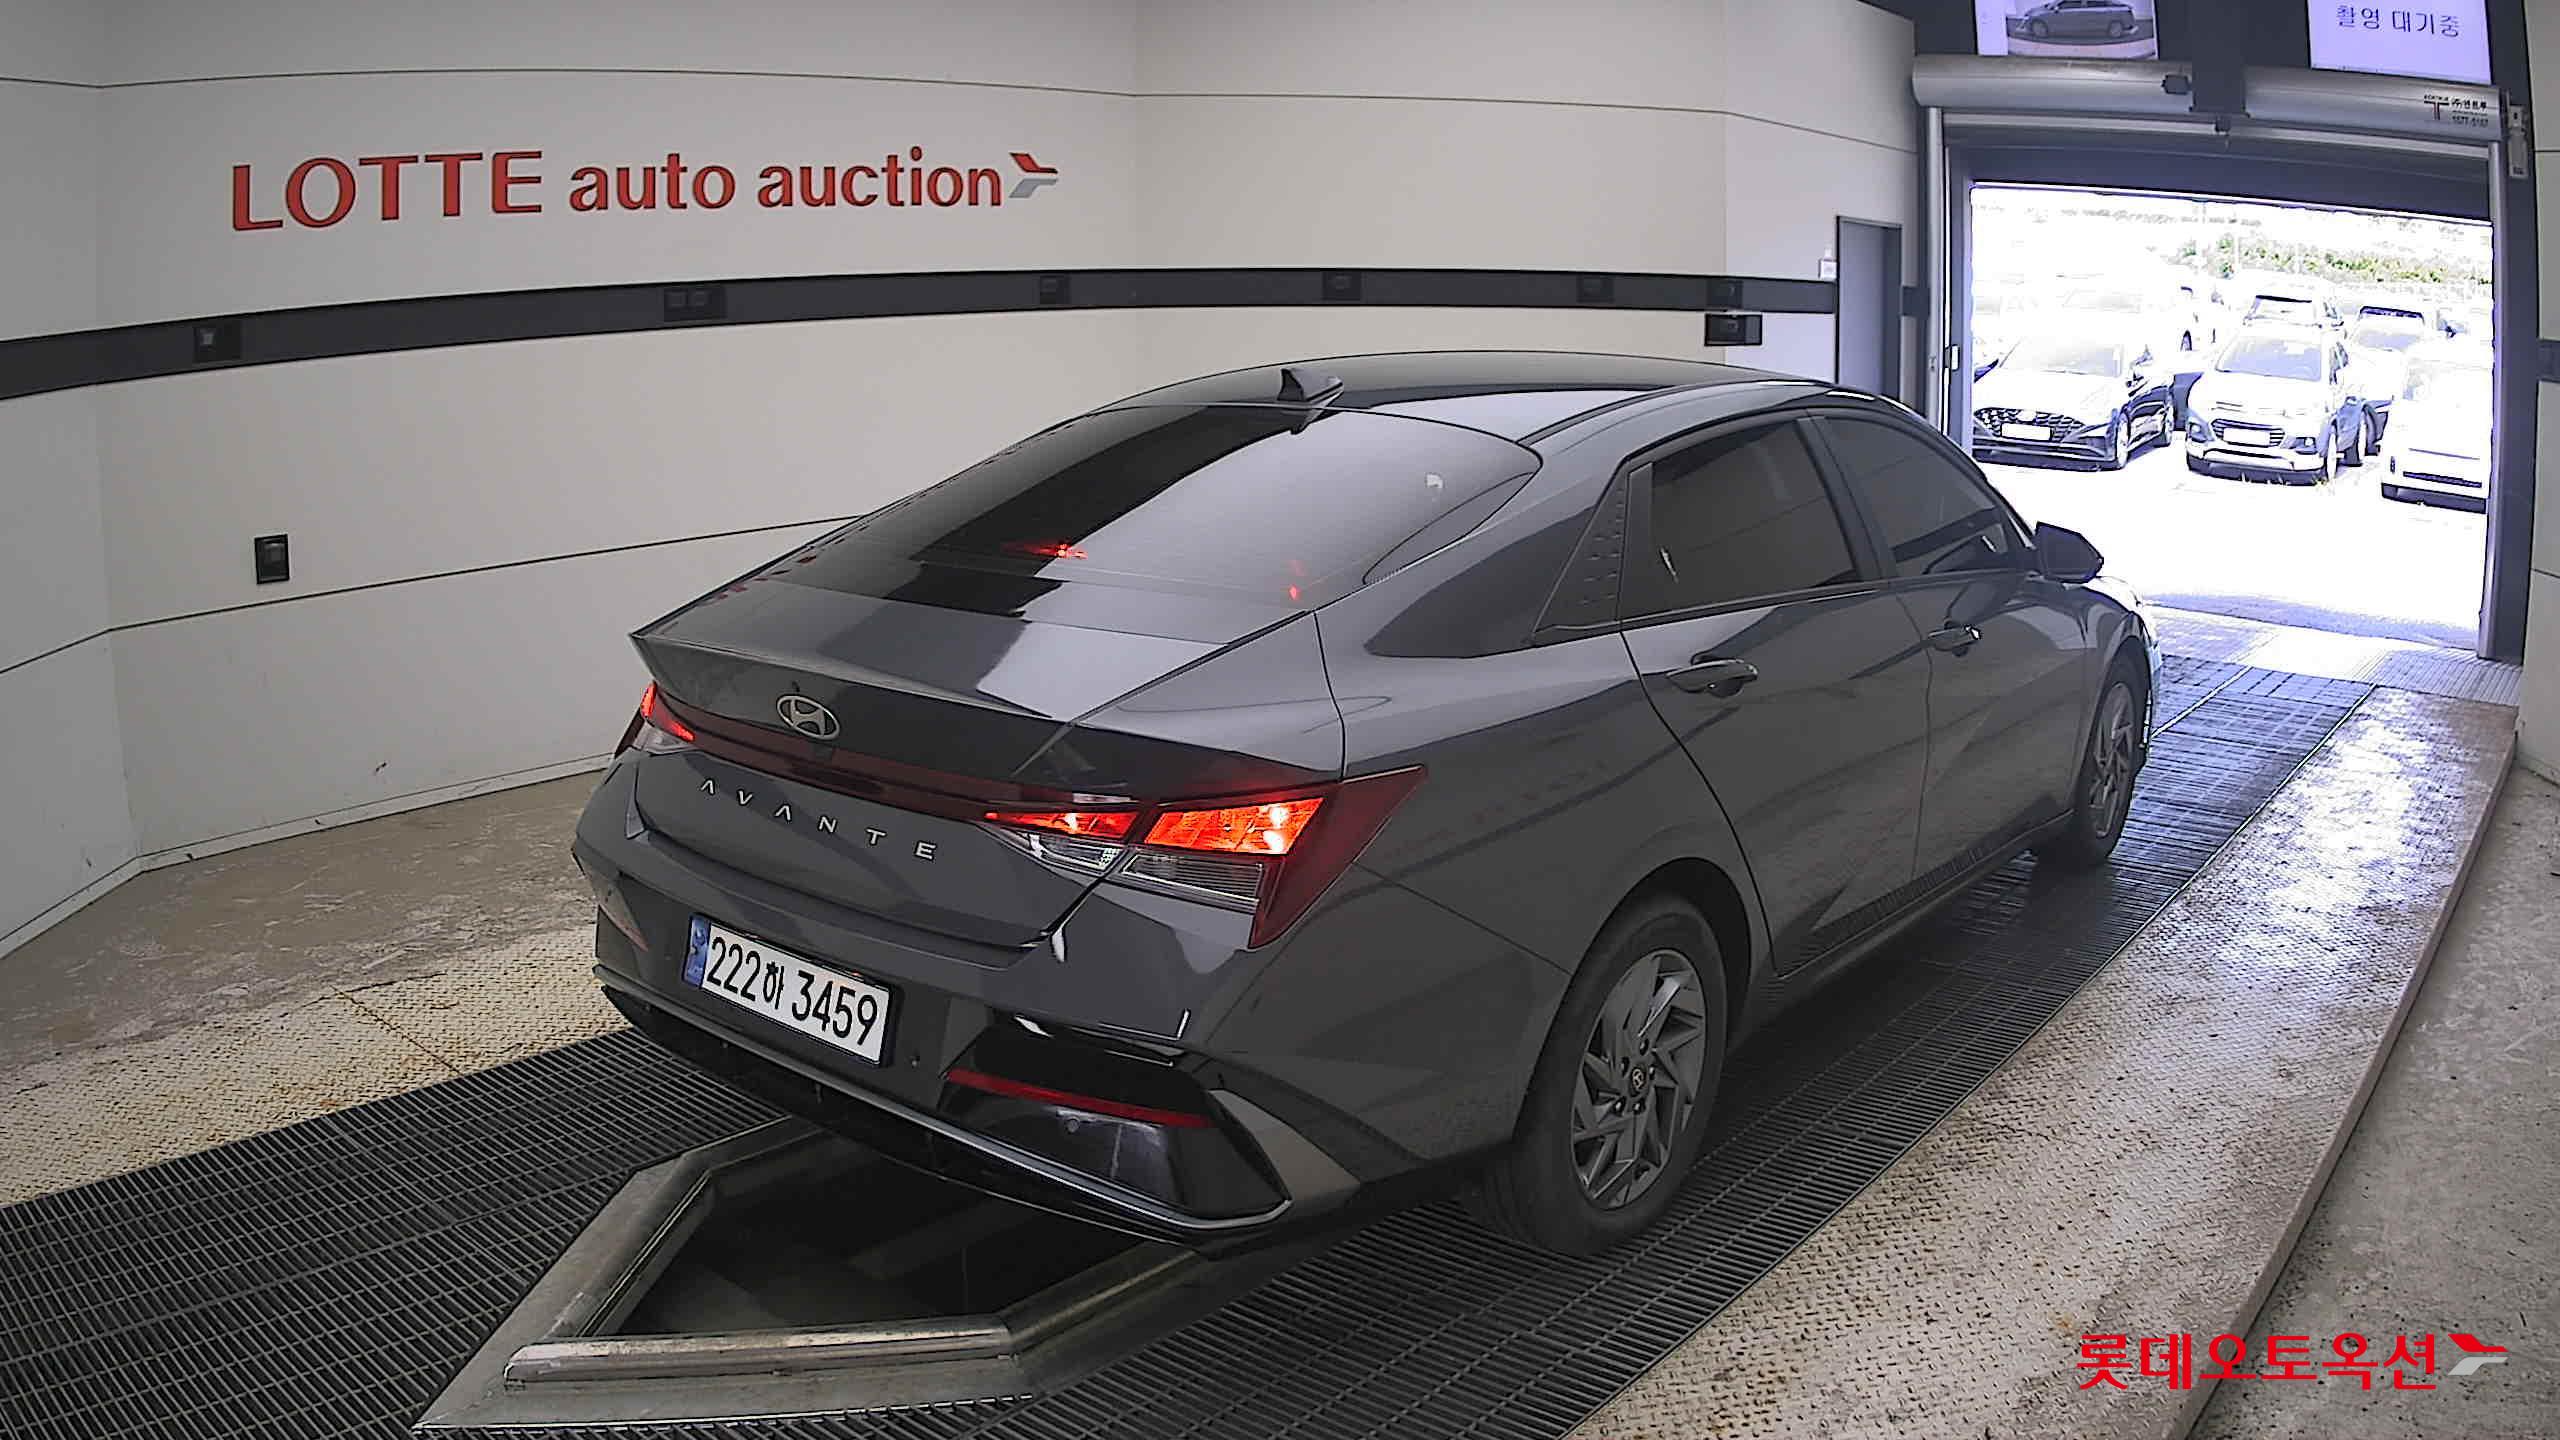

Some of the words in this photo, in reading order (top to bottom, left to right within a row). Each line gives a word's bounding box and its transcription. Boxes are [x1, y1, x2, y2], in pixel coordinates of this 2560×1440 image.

[2336, 5, 2381, 30] 촬영
[2391, 10, 2460, 38] 대기중
[232, 151, 543, 231] LOTTE
[568, 152, 736, 210] auto
[757, 147, 1003, 208] auction
[699, 777, 937, 861] AVANTE
[706, 936, 785, 1010] 222하
[790, 970, 878, 1046] 3459
